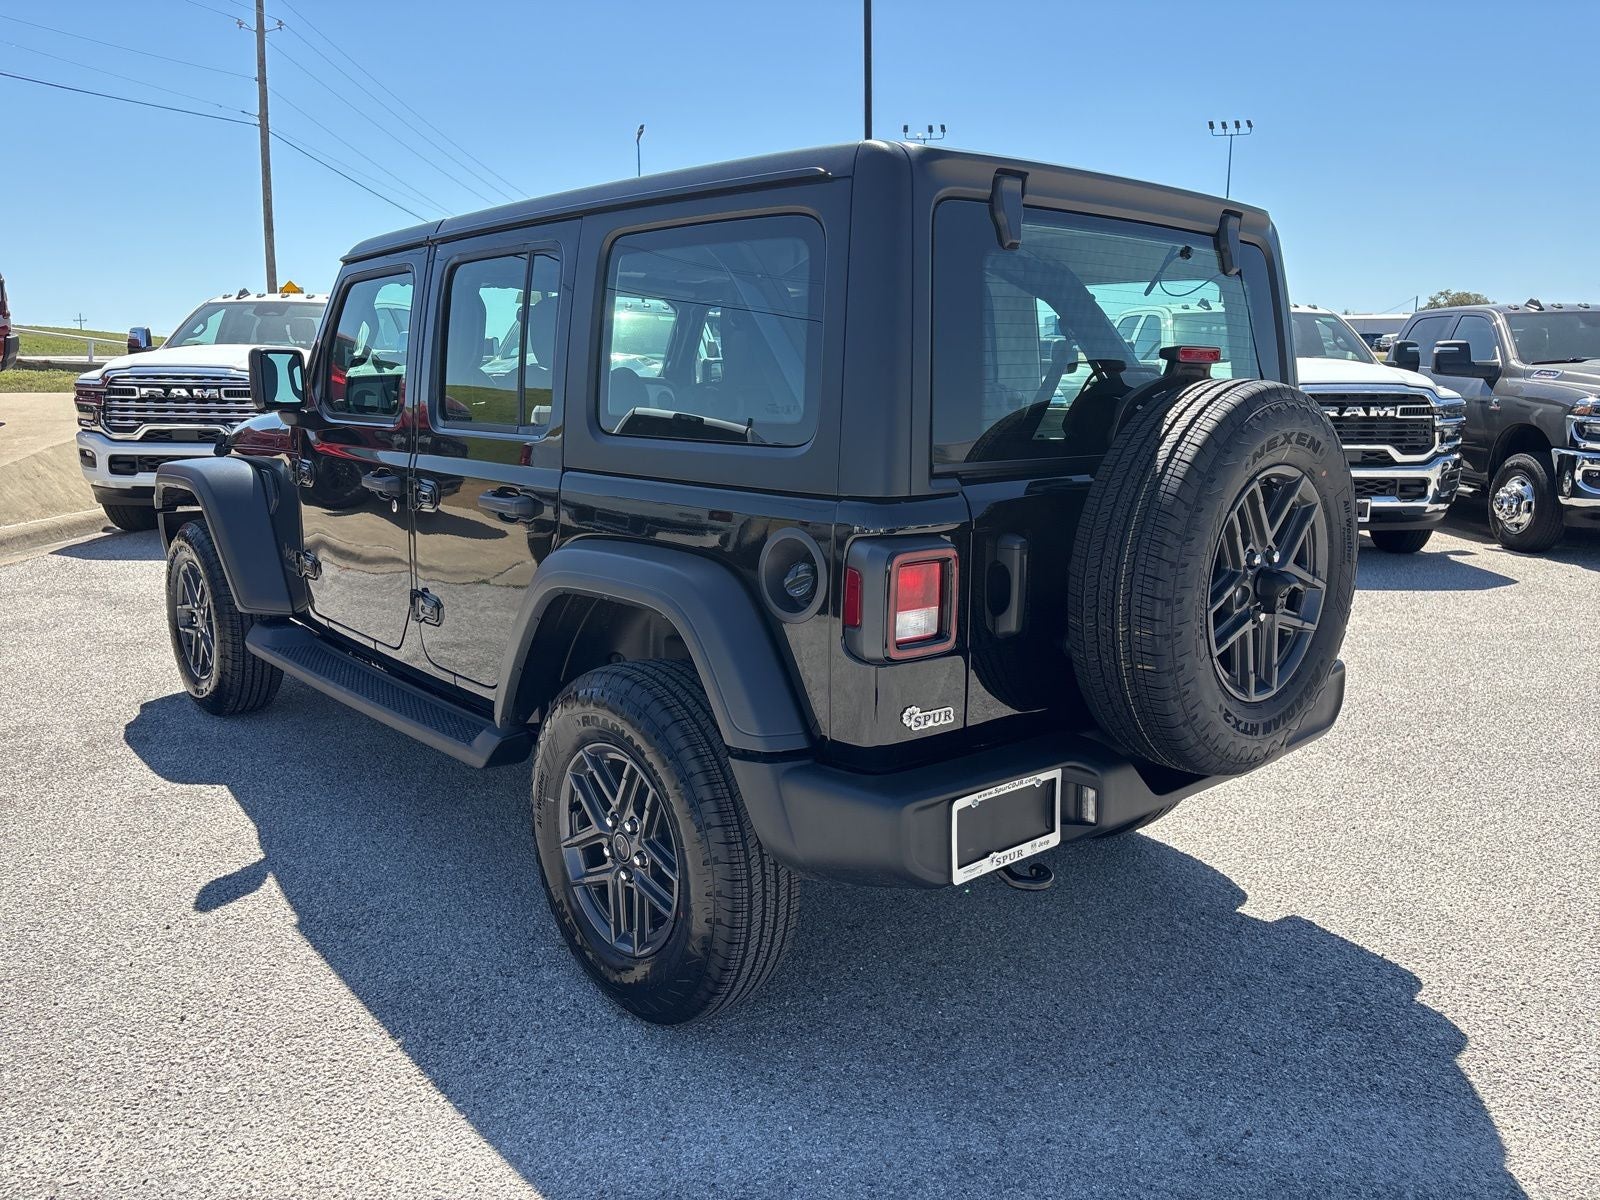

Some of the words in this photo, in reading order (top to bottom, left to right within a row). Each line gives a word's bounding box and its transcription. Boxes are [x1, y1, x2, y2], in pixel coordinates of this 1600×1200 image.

[140, 388, 219, 398] RAM
[1319, 406, 1395, 417] RAM
[1252, 431, 1322, 466] NEXEN
[914, 710, 952, 728] SPUR
[1222, 707, 1259, 736] HTX2
[977, 776, 1038, 799] www.SpurCDJR.com
[536, 771, 545, 829] All-Weather
[995, 849, 1024, 866] SPUR
